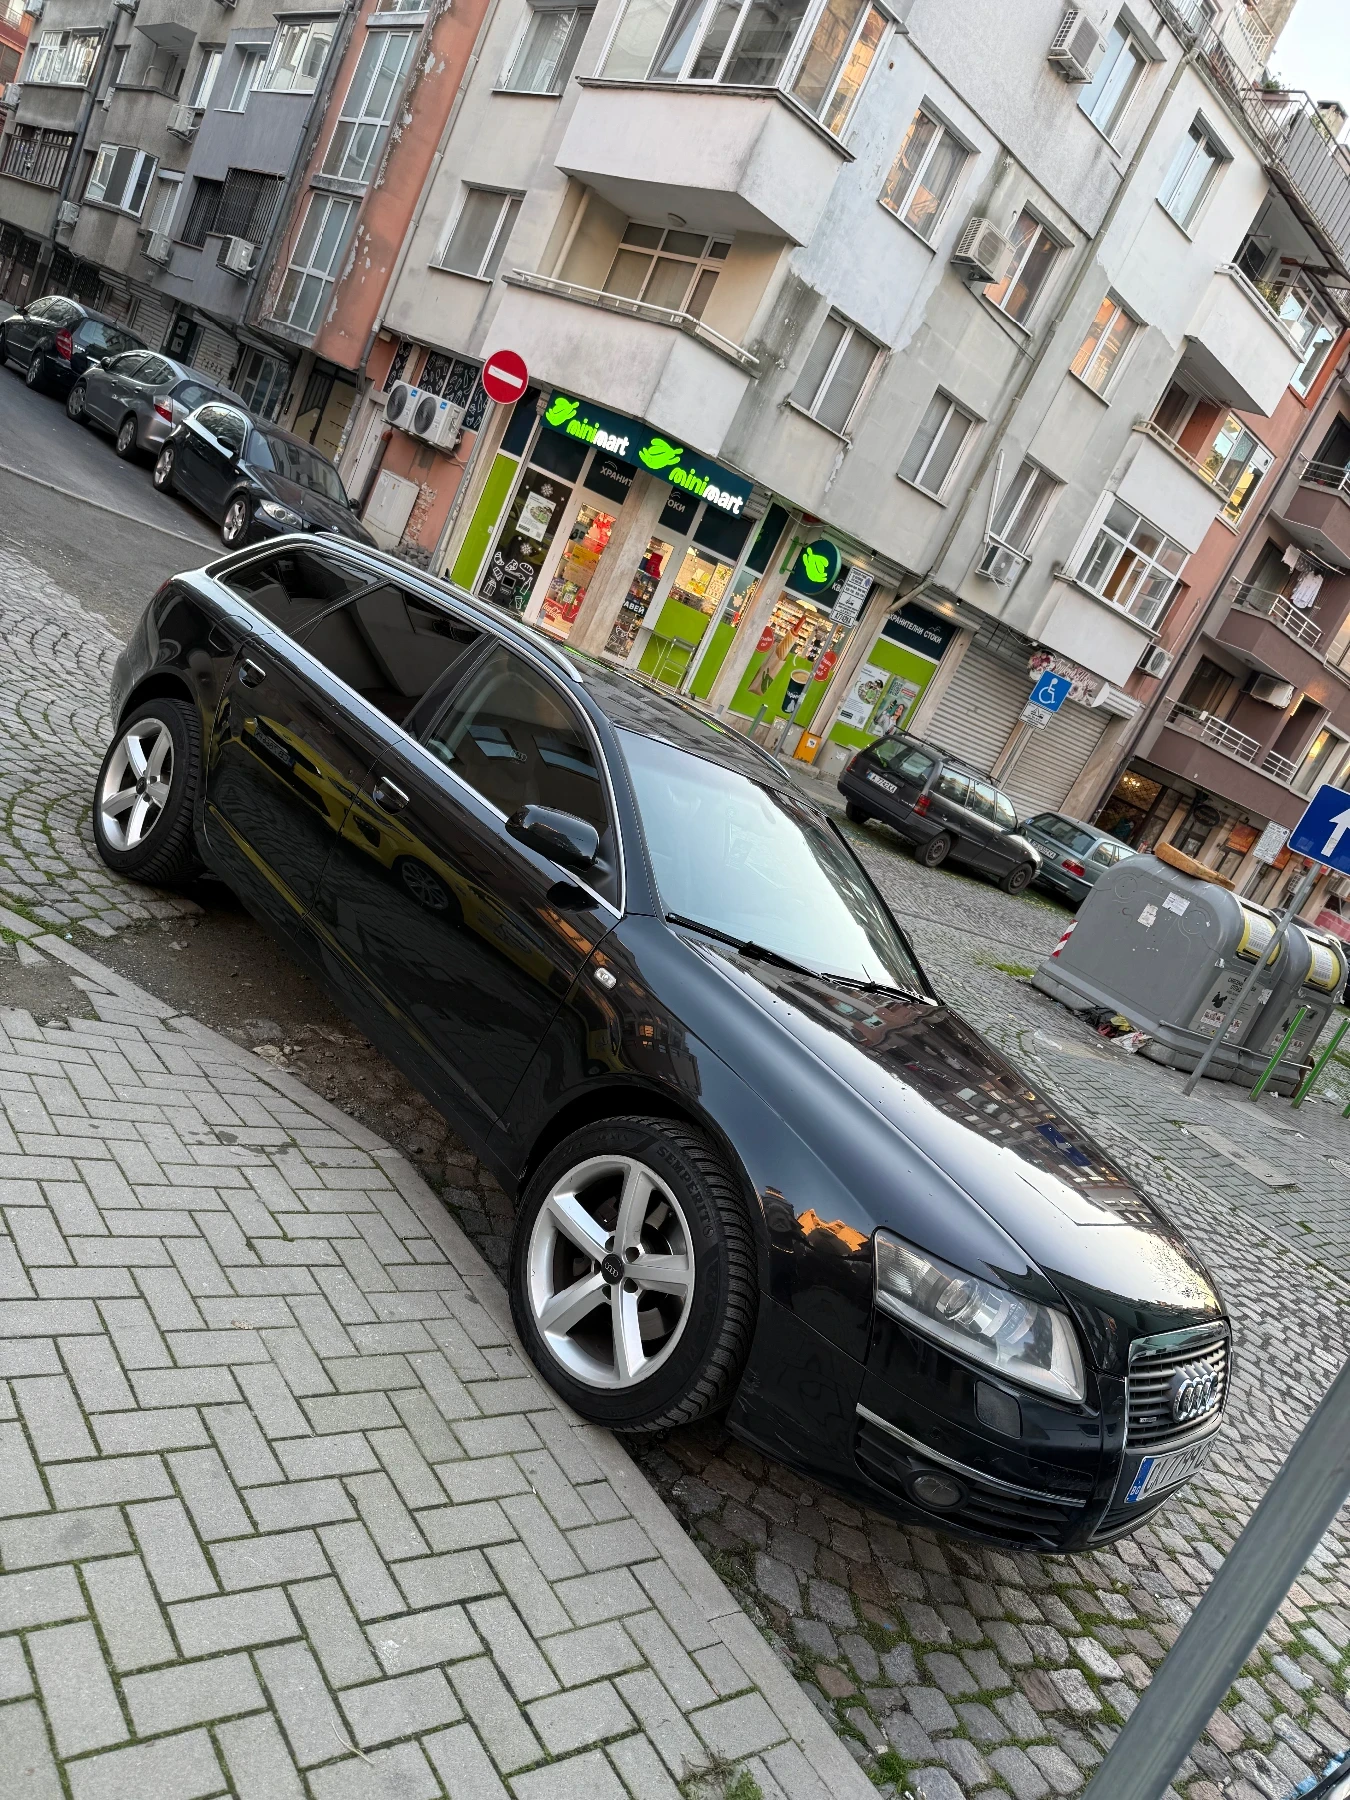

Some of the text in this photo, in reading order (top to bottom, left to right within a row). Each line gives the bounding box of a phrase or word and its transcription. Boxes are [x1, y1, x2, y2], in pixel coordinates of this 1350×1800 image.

[566, 418, 629, 456] minimart
[667, 499, 685, 513] ОКИ
[668, 467, 743, 514] minimart
[622, 600, 645, 615] АВЕЙ
[888, 613, 924, 635] ХРАНИТЕЛНИ
[923, 630, 942, 644] СТОКИ
[655, 1145, 711, 1223] SEMPERIT
